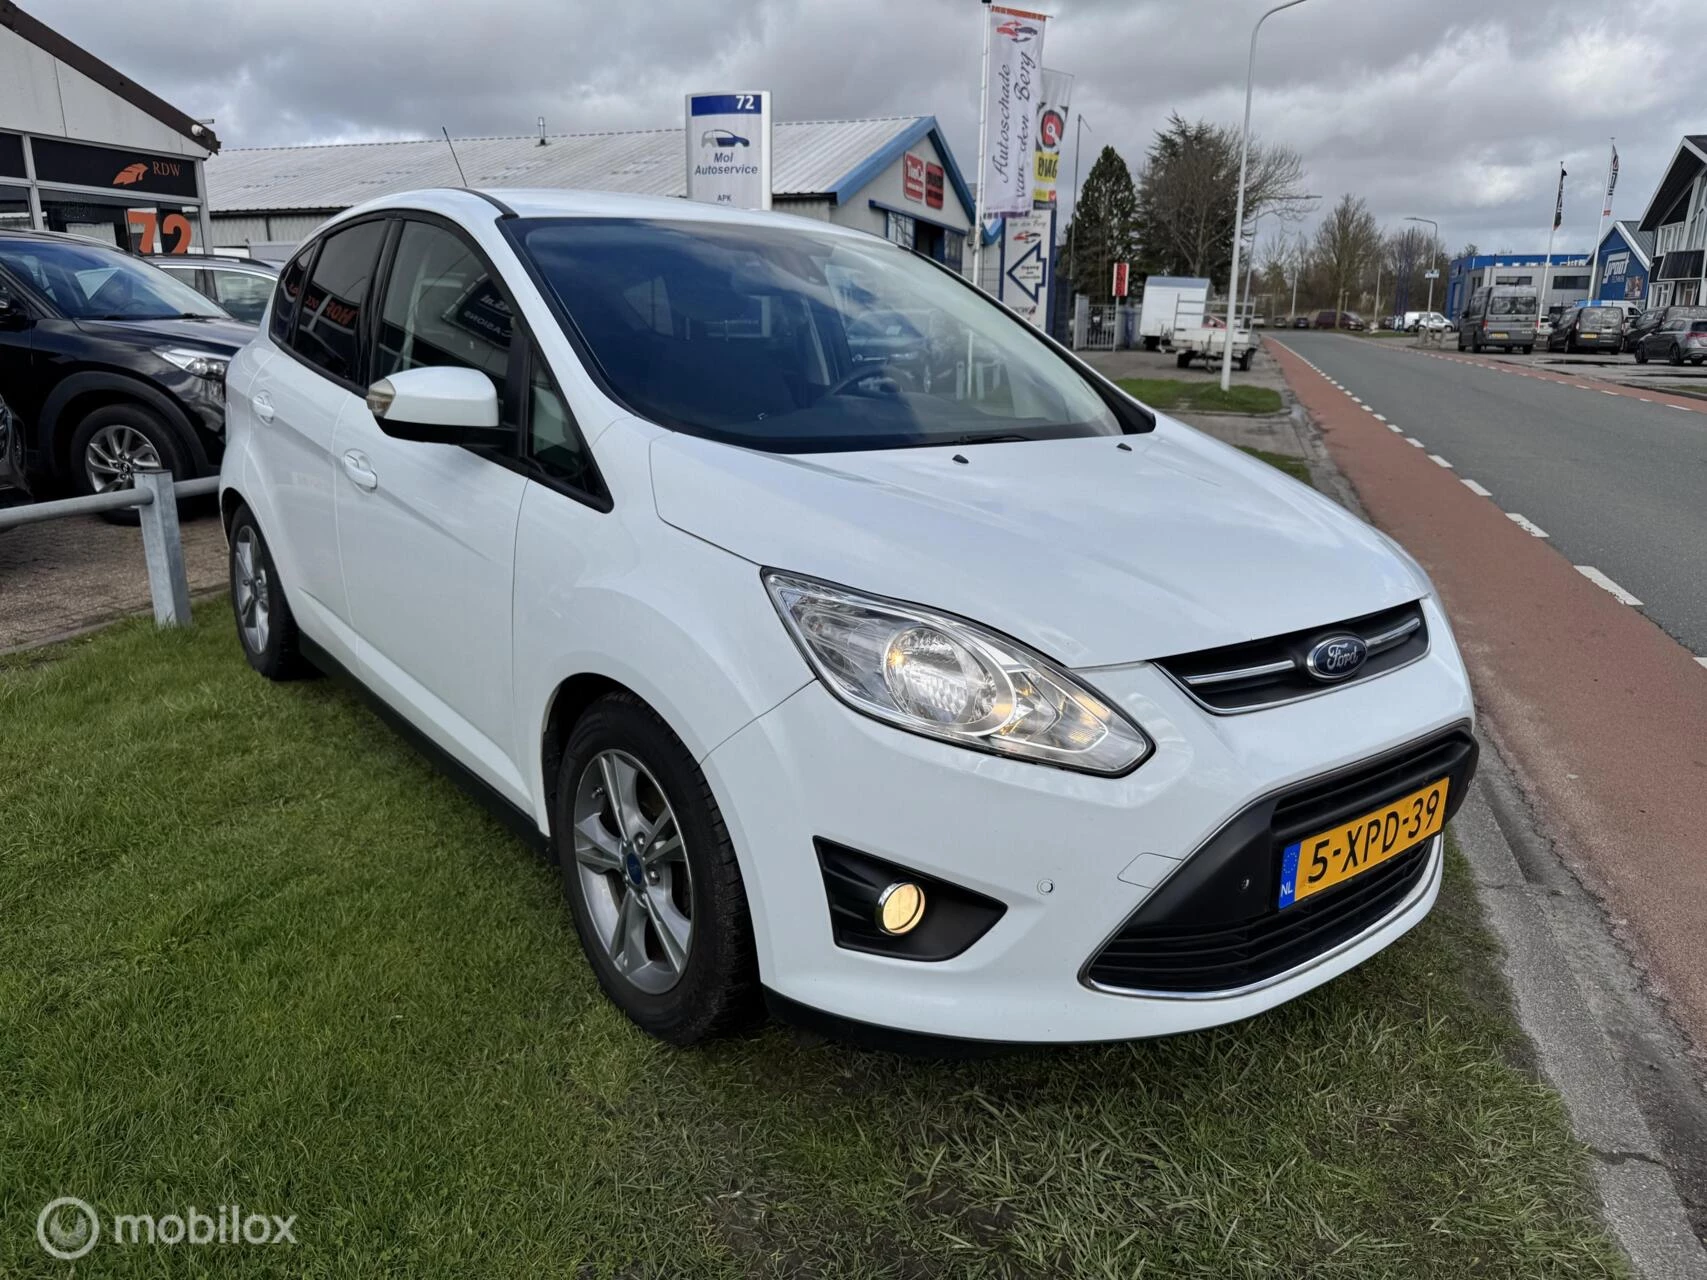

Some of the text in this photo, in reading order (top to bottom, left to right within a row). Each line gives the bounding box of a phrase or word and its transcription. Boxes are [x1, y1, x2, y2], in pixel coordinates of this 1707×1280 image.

[1013, 51, 1036, 102] Berg
[735, 95, 755, 110] 72
[991, 63, 1011, 184] Autoschade
[1017, 113, 1030, 153] den
[152, 161, 182, 177] RDW
[694, 164, 759, 176] Autoservice
[713, 152, 734, 163] Mol
[127, 211, 193, 255] 72
[1327, 643, 1359, 670] Ford
[1307, 789, 1440, 884] 5-XPD-39
[1280, 880, 1294, 897] NL
